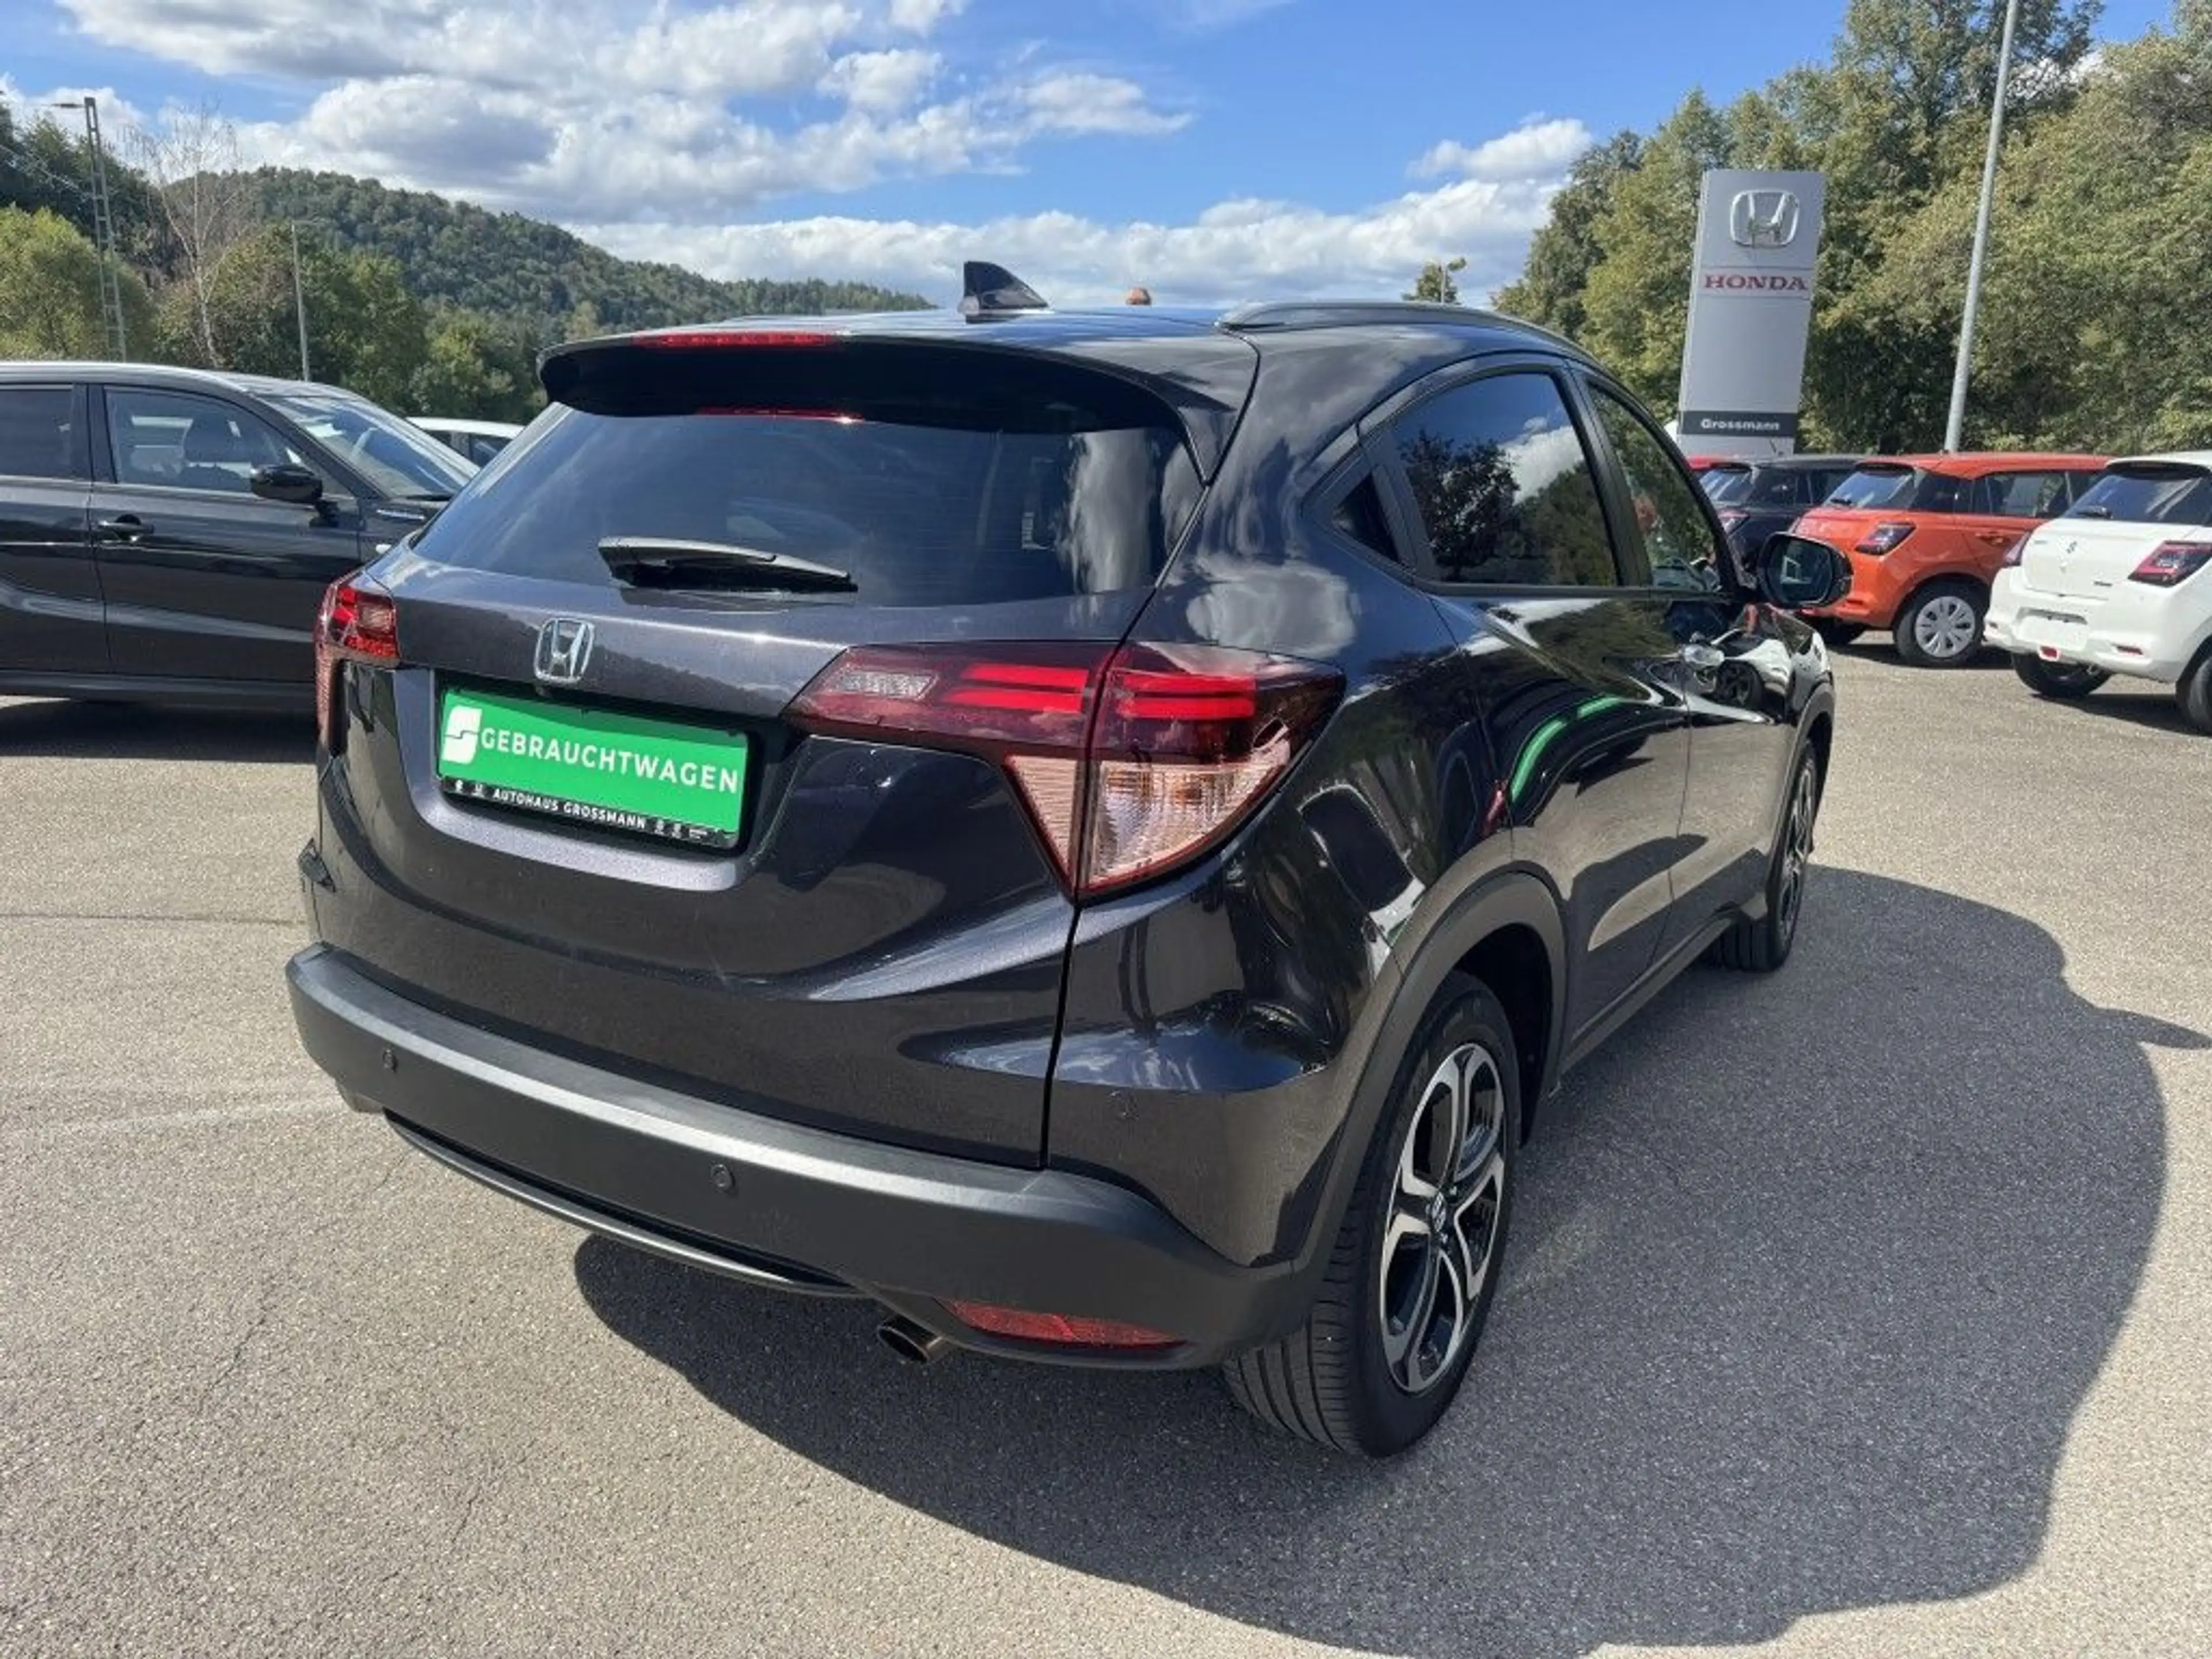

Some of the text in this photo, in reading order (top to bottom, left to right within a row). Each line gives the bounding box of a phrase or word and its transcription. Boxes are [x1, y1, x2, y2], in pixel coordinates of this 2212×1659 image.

[1705, 274, 1809, 290] HONDA
[1700, 418, 1780, 430] Grossmann
[480, 728, 738, 794] GEBRAUCHTWAGEN
[493, 788, 646, 829] AUTOHAUS GROSSMANN
